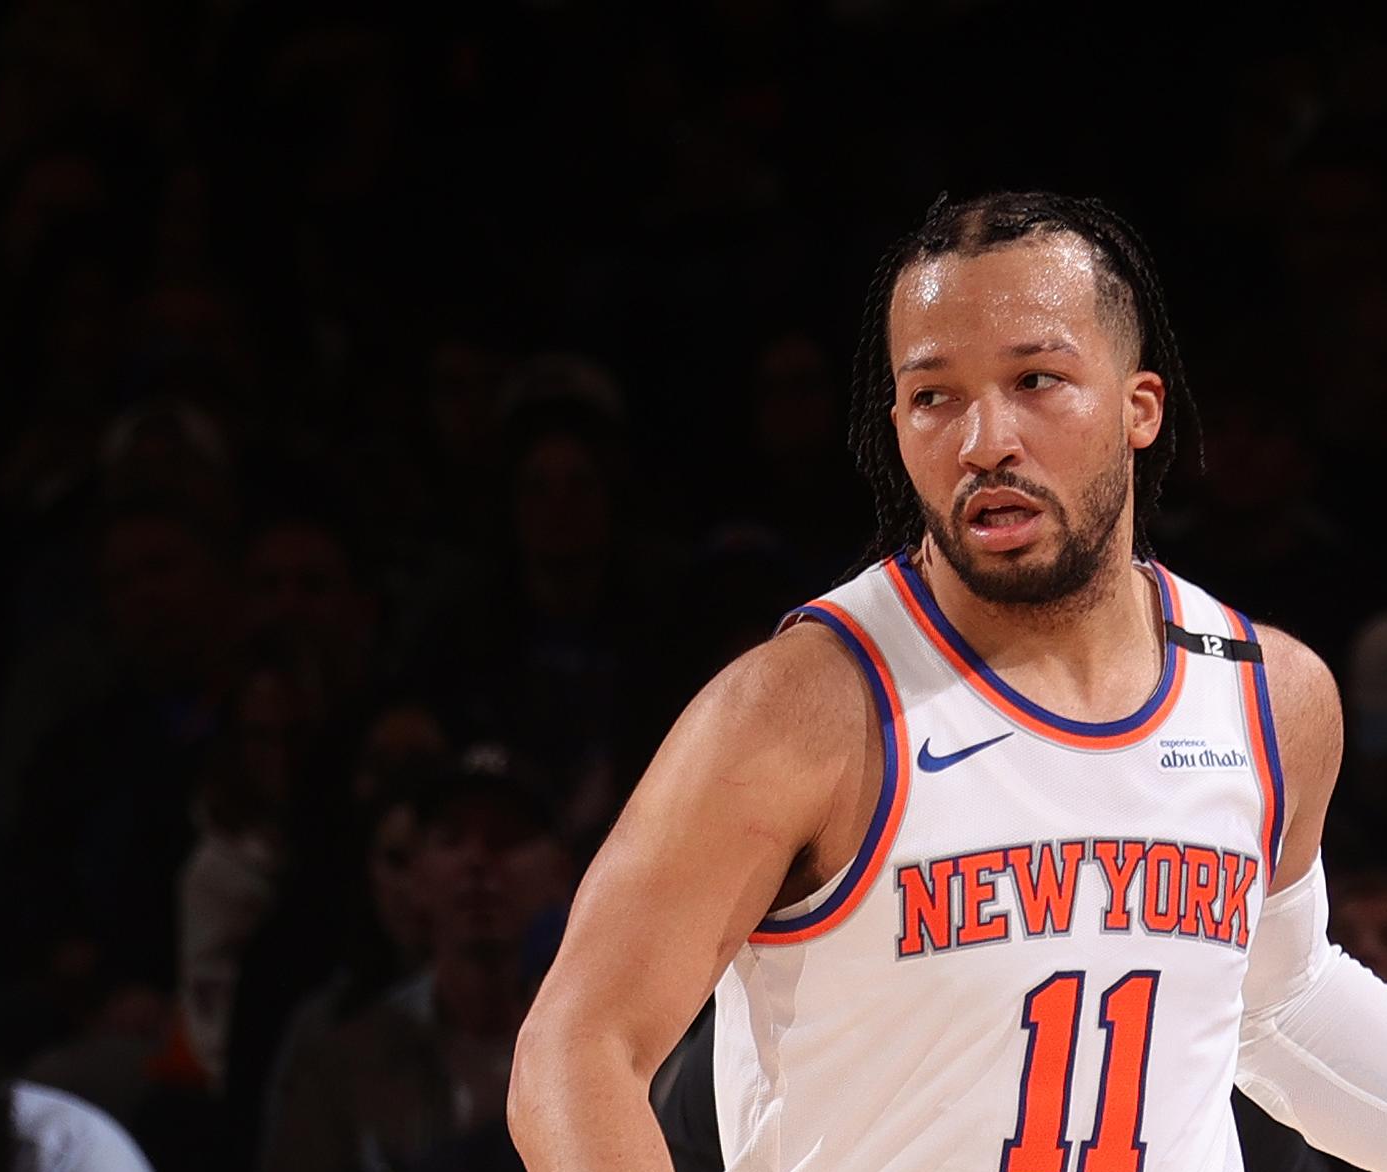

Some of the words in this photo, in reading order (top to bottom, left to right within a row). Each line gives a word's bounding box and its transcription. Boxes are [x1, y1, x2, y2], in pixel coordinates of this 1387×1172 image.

[1201, 635, 1225, 657] 12
[1160, 739, 1206, 749] experience
[1161, 750, 1196, 768] abu
[895, 840, 1087, 961] NEW
[1091, 837, 1261, 953] YORK
